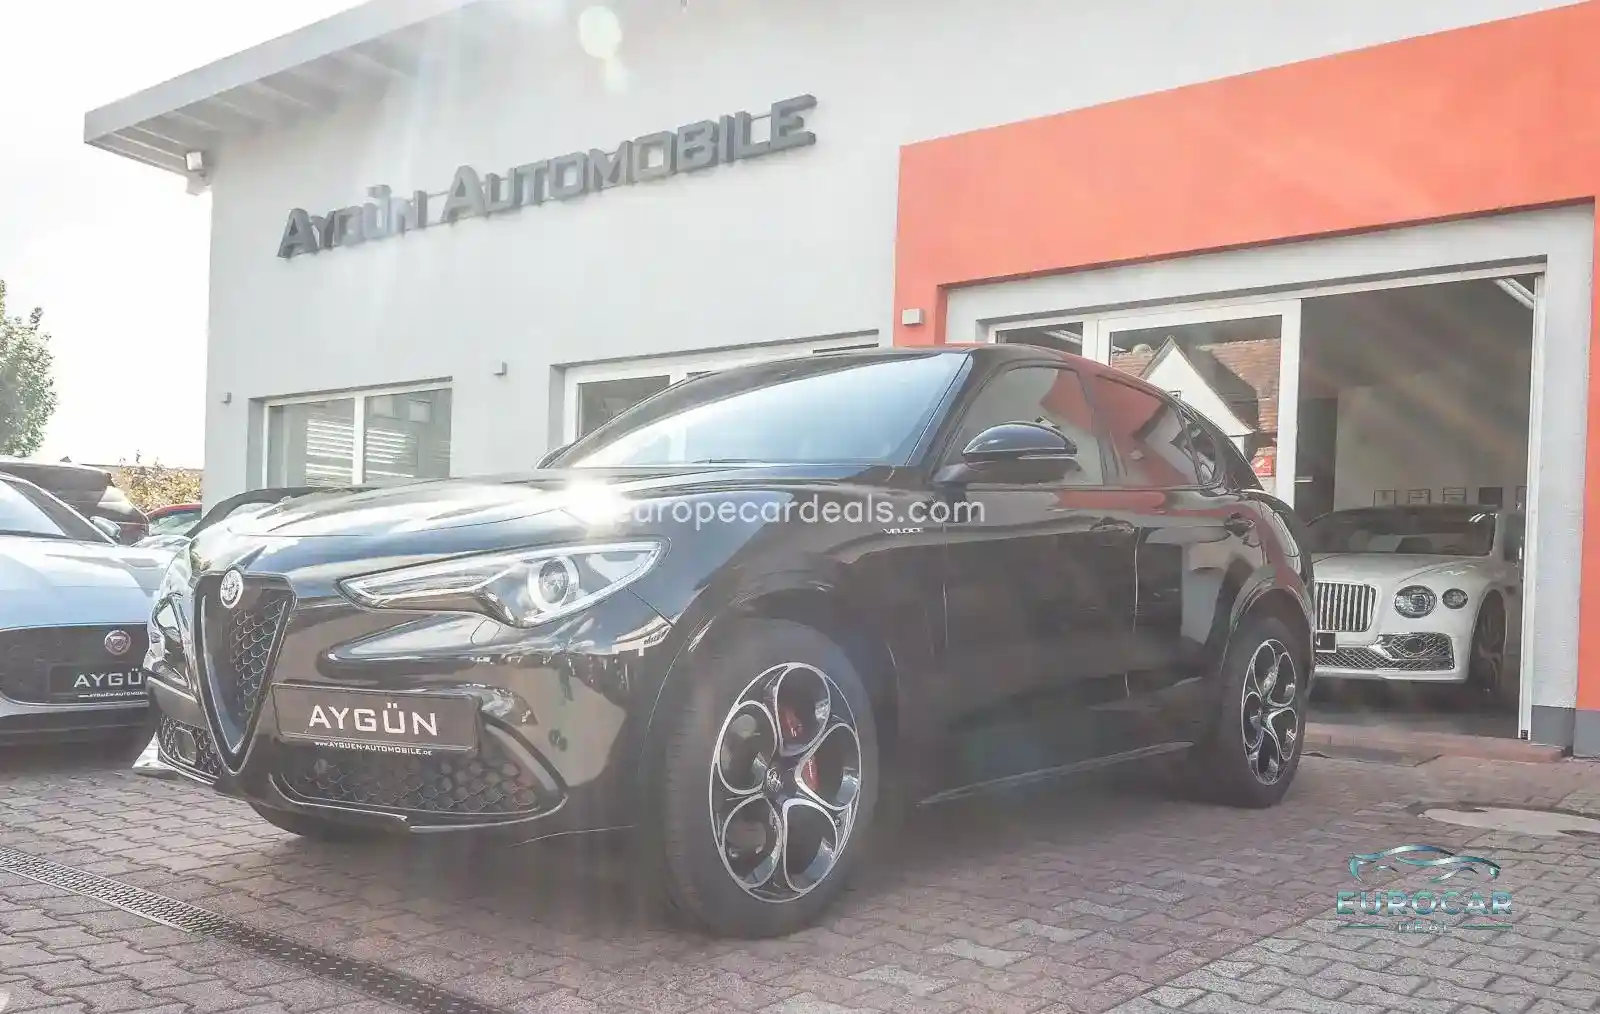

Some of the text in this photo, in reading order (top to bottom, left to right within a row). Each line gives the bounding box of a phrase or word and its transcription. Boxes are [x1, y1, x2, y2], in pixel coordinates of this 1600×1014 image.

[440, 93, 817, 227] AUTOMOBILE
[73, 667, 143, 688] AYGÜ
[308, 702, 438, 737] AYGÜN
